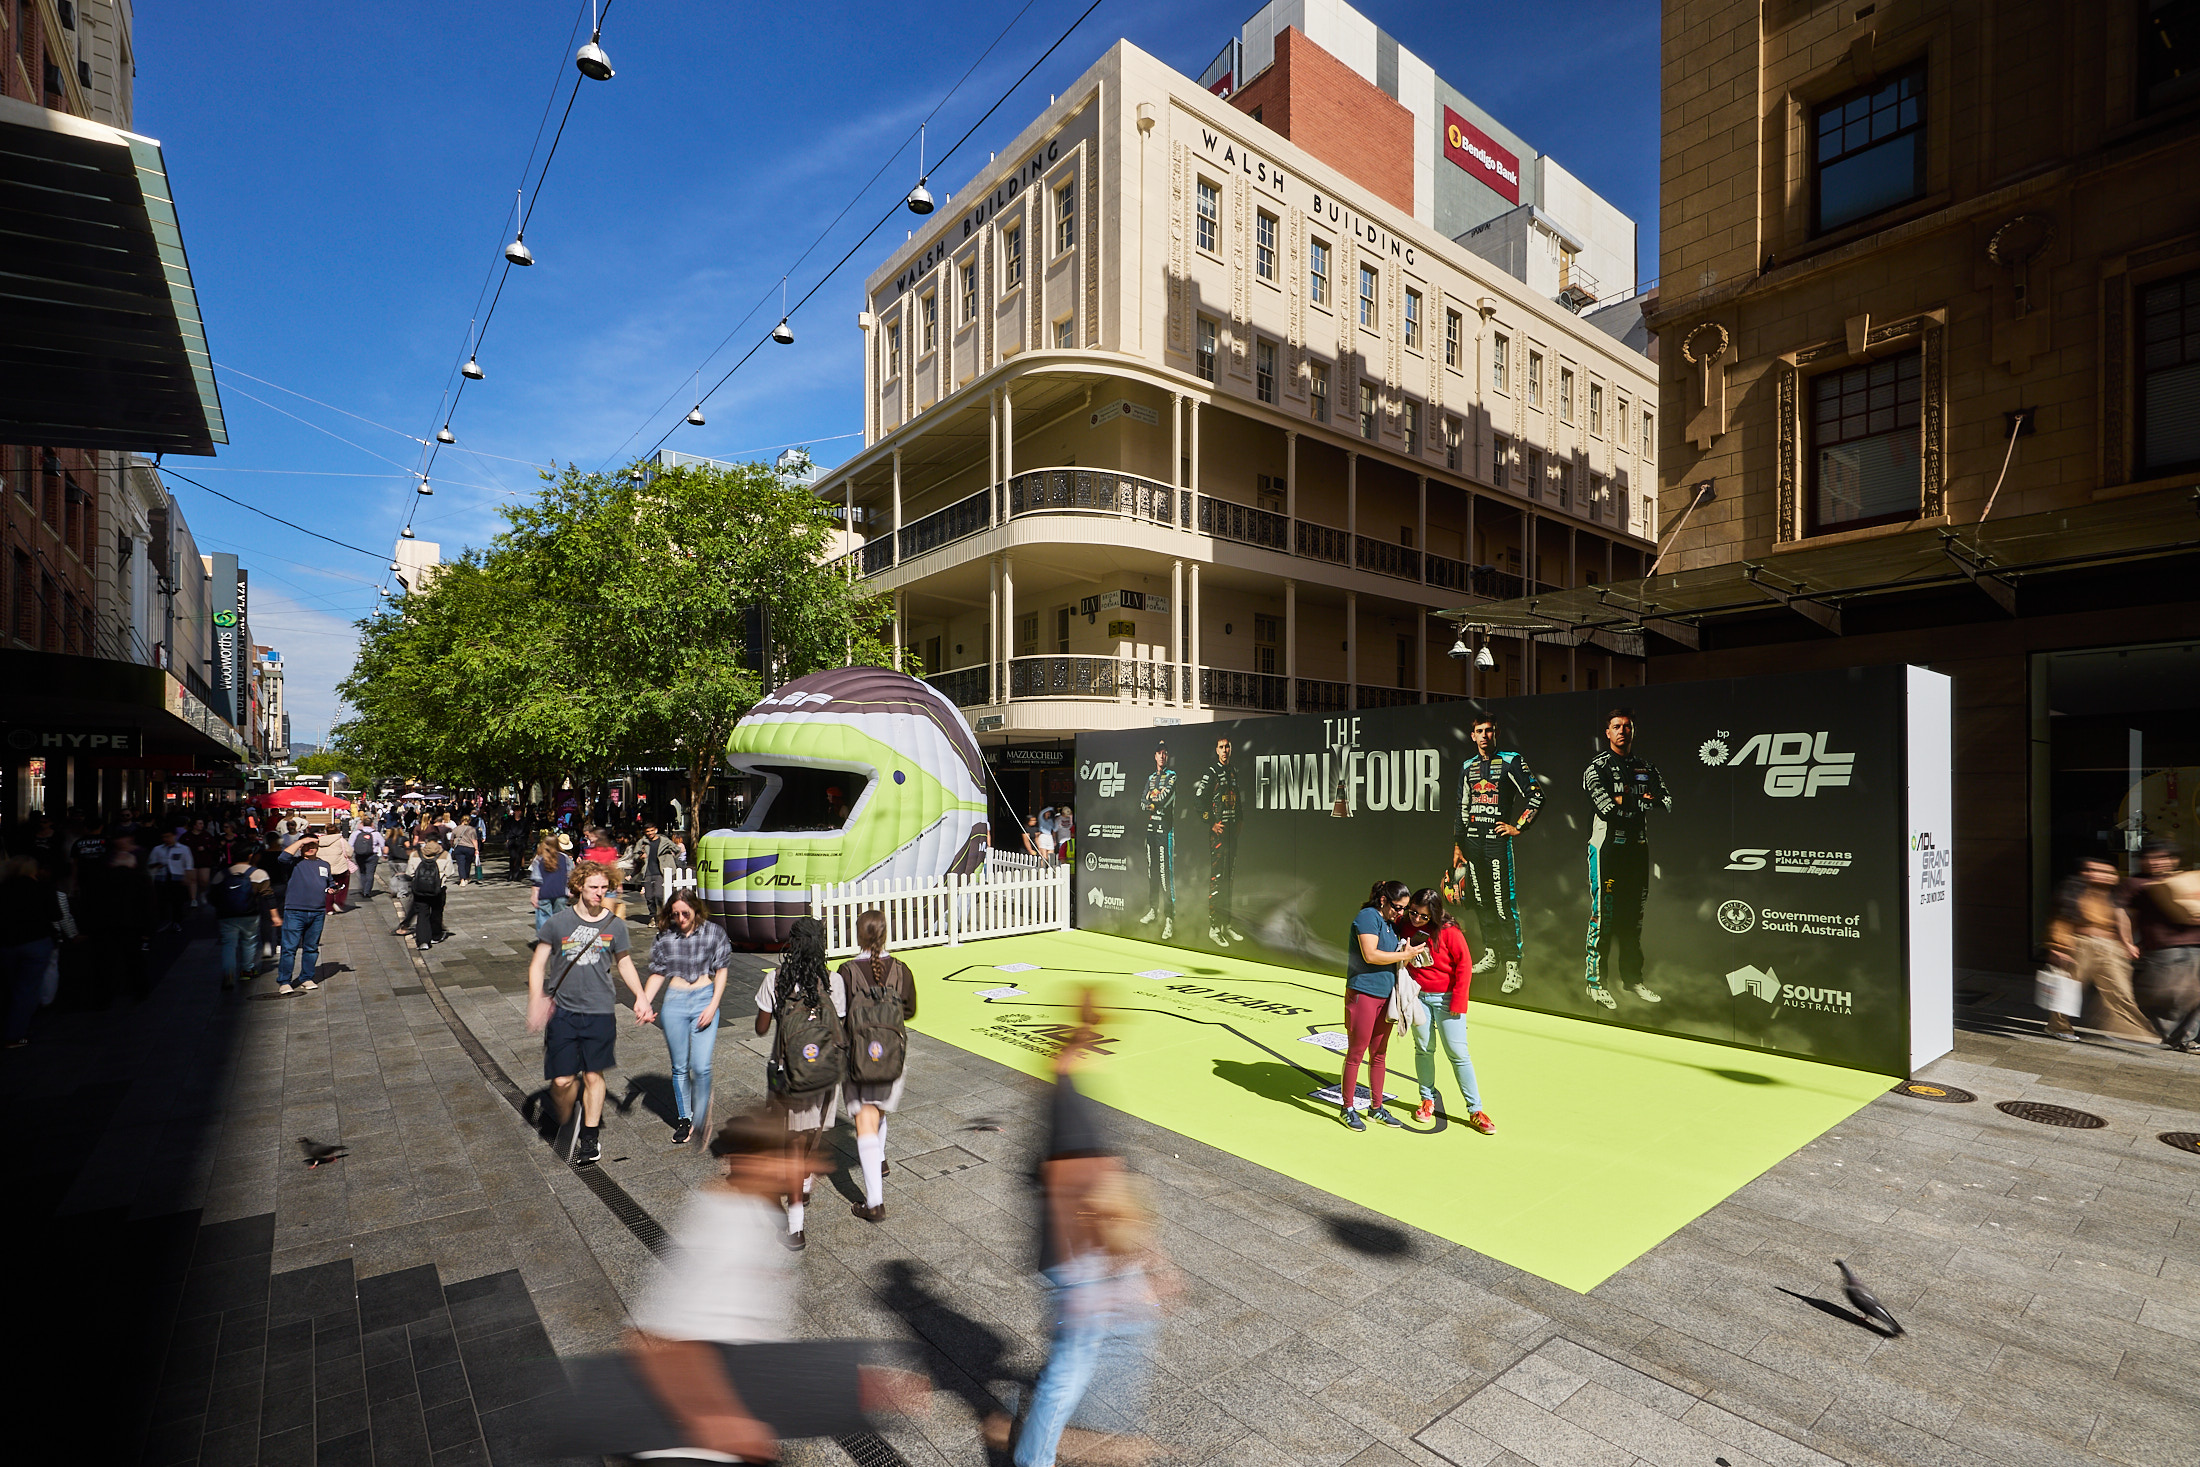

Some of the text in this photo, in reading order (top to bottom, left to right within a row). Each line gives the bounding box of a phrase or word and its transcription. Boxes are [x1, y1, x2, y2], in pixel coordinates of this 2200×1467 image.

[1462, 135, 1518, 186] Bendigo Bank
[1202, 128, 1415, 266] WALSH BUILDING
[896, 140, 1058, 295] WALSH BUILDING
[236, 581, 246, 613] PLAZA
[217, 632, 232, 690] Woolworths
[236, 664, 246, 716] ADELAIDE
[42, 733, 129, 749] HYPE
[1323, 716, 1361, 749] THE
[1716, 729, 1730, 739] bp
[1727, 731, 1856, 766] ADL
[1088, 761, 1126, 780] ADL
[1255, 748, 1441, 812] FINAL FOUR
[1763, 764, 1853, 798] GF
[1098, 780, 1126, 798] GF
[1916, 832, 1936, 851] ADL
[1775, 850, 1853, 859] SUPERCARS
[1775, 857, 1811, 865] FINALS
[1922, 849, 1950, 870] GRAND
[764, 875, 802, 886] ADL
[1807, 866, 1840, 875] Repco
[1920, 868, 1946, 890] FINAL
[1723, 902, 1749, 913] SOUTH
[1761, 908, 1861, 926] Government of
[1761, 920, 1861, 939] South Australia
[1165, 984, 1216, 995] 40
[1203, 992, 1313, 1016] YEARS
[1782, 983, 1852, 1007] SOUTH
[1783, 999, 1852, 1015] AUSTRALIA
